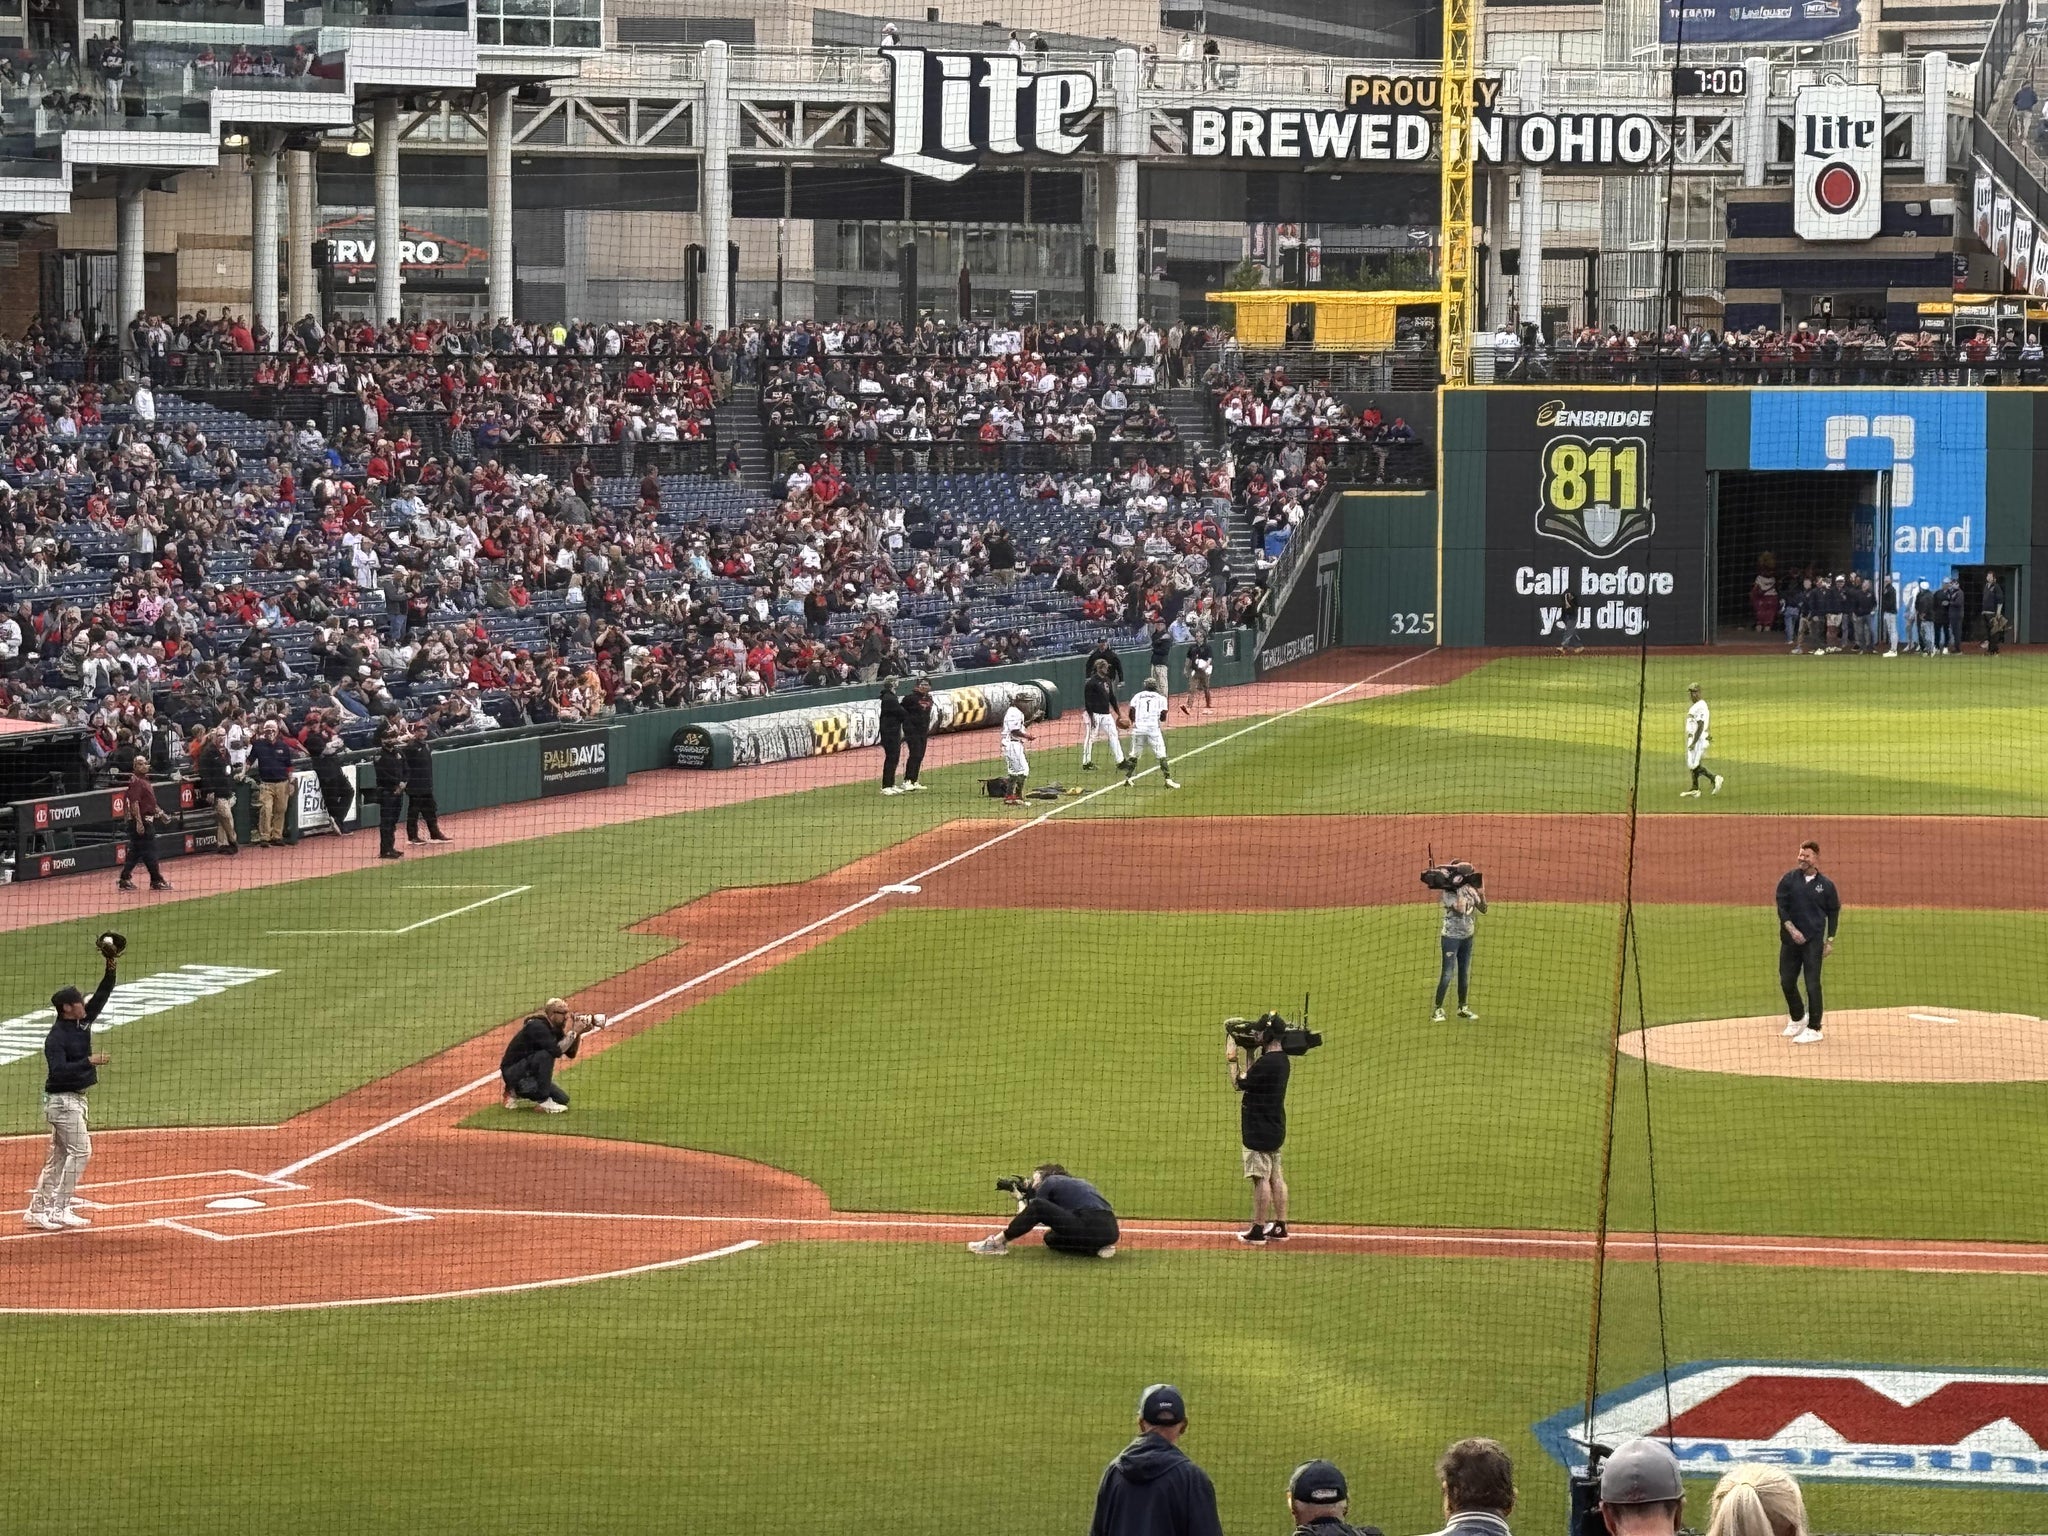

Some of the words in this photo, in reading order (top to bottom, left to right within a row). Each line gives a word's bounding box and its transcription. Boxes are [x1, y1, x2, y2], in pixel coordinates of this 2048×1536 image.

[1694, 69, 1744, 94] 7:00
[880, 49, 1095, 183] Lite
[1192, 110, 1430, 162] BREWED
[1521, 115, 1653, 164] OHIO
[1802, 115, 1875, 160] Lite
[1550, 444, 1638, 511] 811
[1515, 566, 1570, 595] Call
[1581, 566, 1674, 595] before
[1389, 612, 1435, 635] 325
[571, 743, 606, 767] DAVIS
[50, 805, 81, 820] TOYOTA
[53, 858, 76, 870] TOYOTA
[1671, 1443, 2048, 1473] Marath
